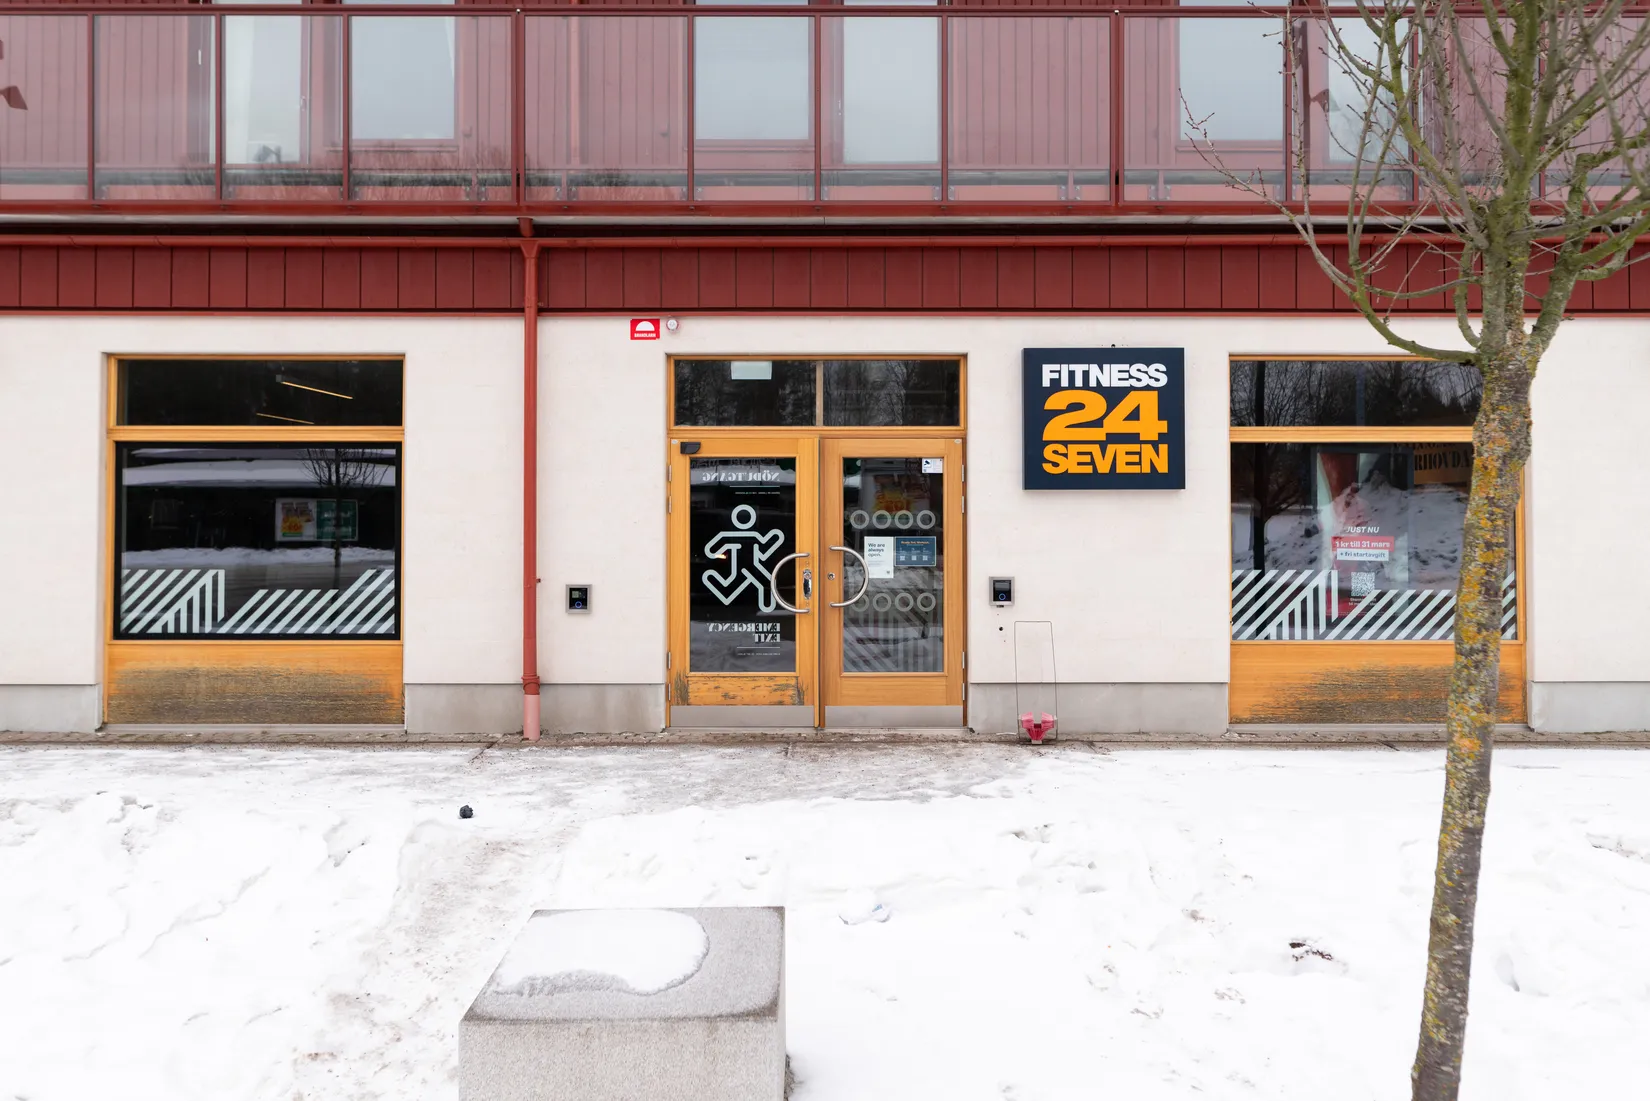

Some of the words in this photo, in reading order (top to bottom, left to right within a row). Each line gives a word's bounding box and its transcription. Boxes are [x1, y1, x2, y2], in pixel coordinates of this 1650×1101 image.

[1042, 363, 1168, 388] FITNESS
[1042, 389, 1168, 441] 24
[1042, 443, 1169, 475] SEVEN
[1346, 526, 1366, 534] JUST
[1367, 526, 1380, 534] NU
